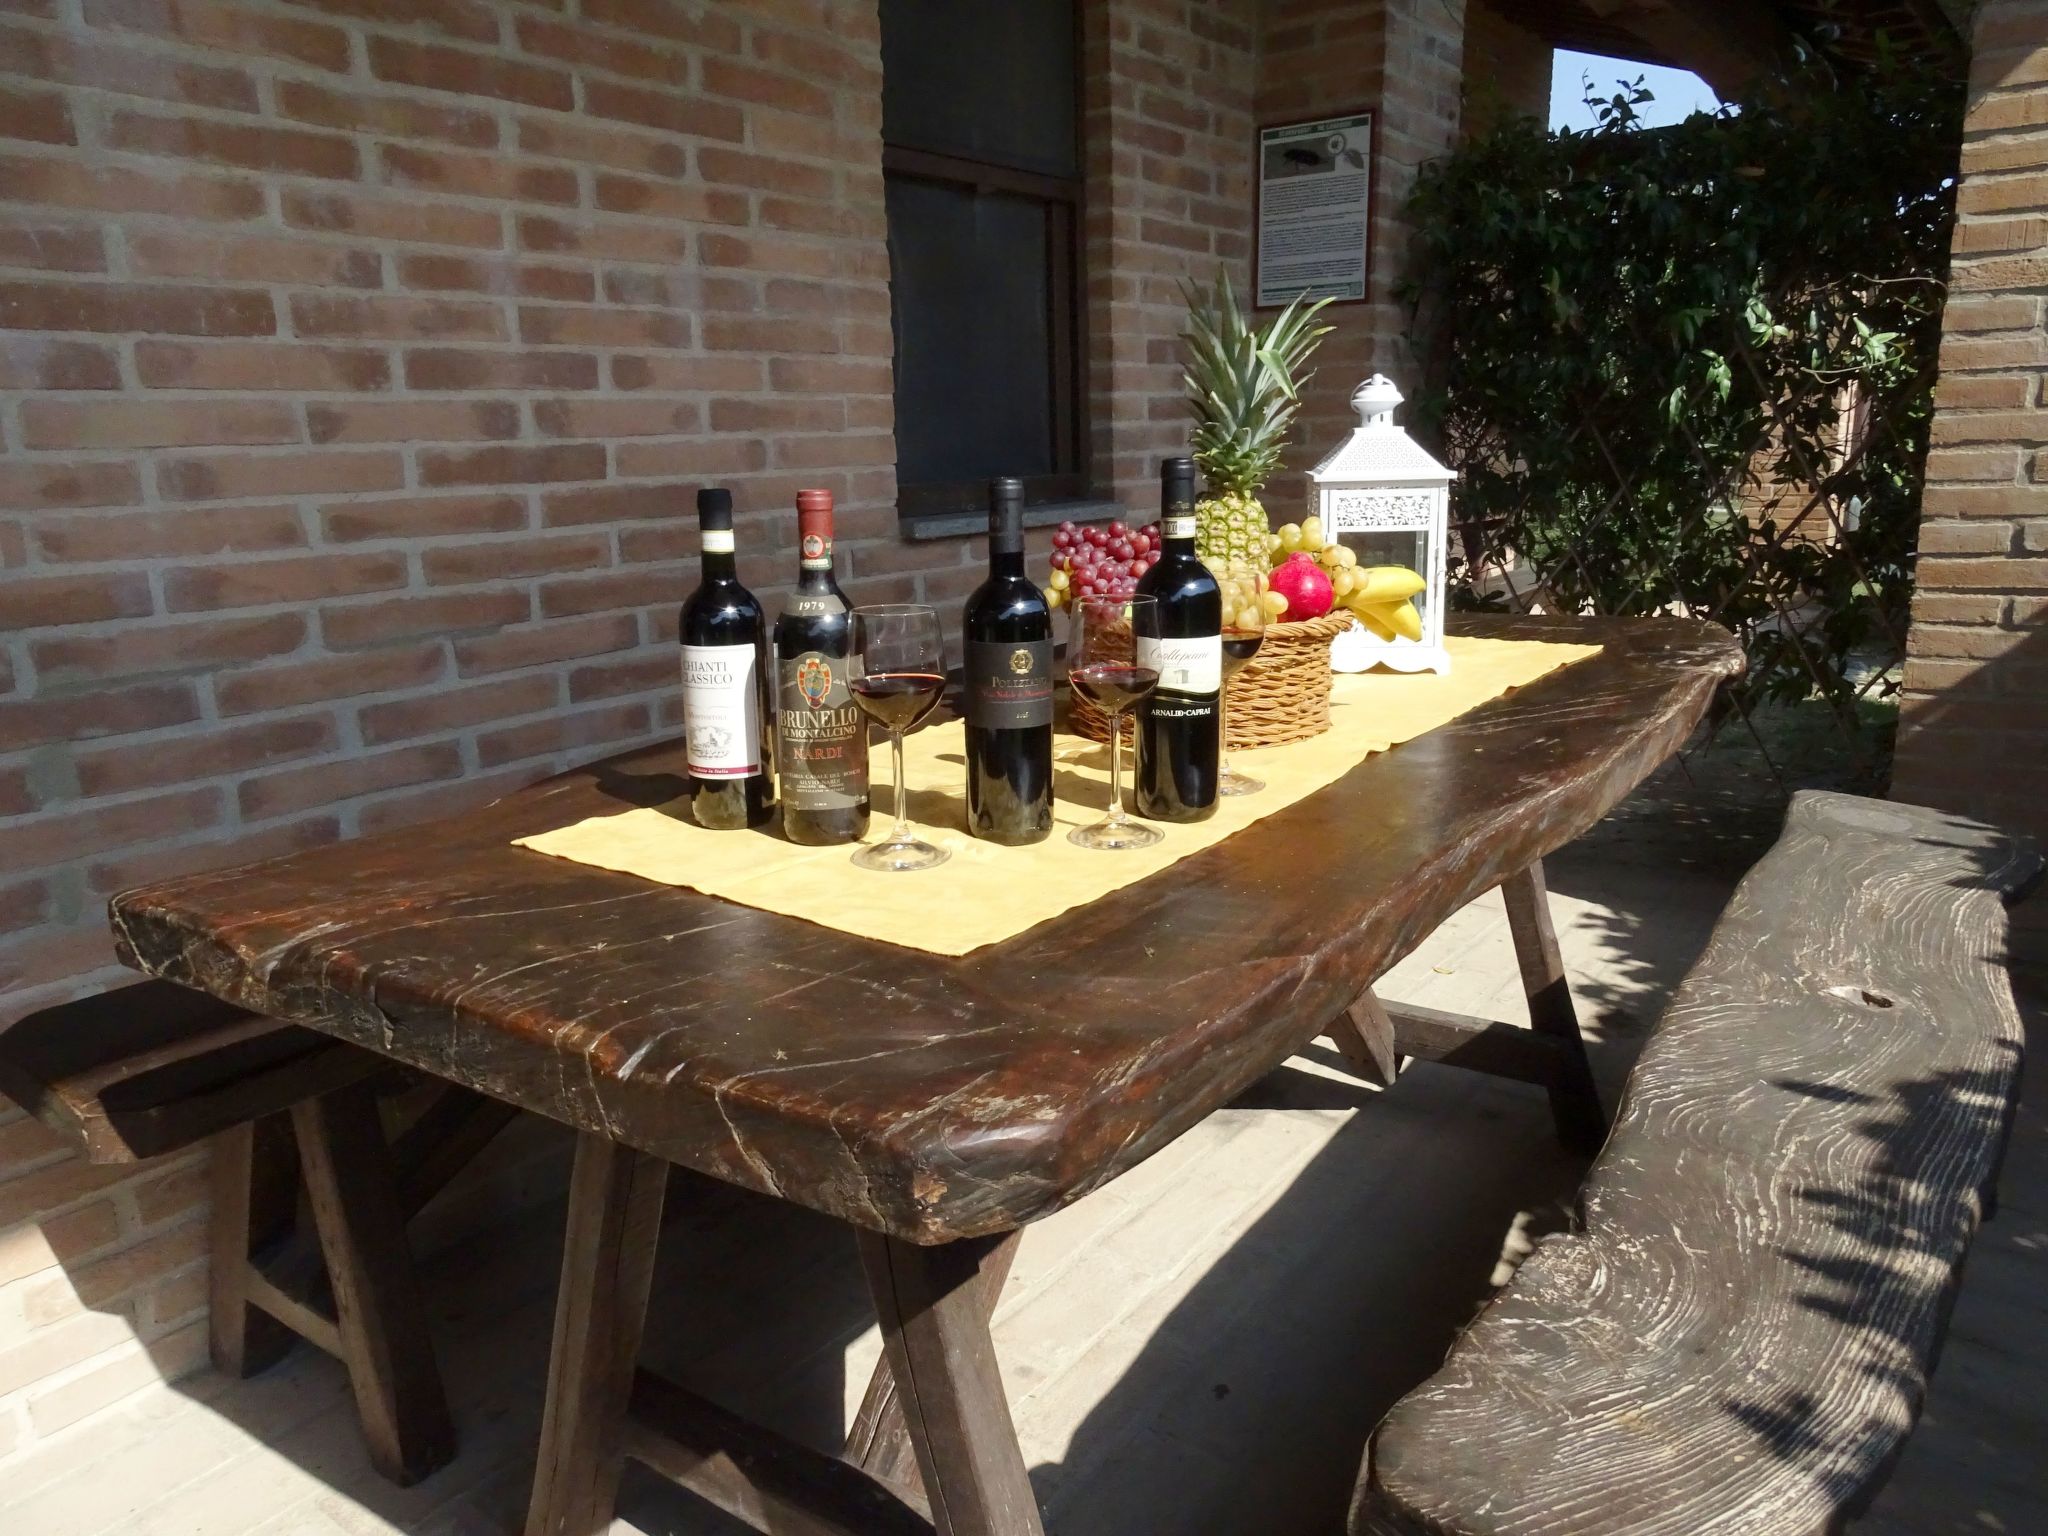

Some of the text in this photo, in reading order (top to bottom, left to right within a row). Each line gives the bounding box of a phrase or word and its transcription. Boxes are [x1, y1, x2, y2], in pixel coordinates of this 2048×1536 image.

[799, 601, 825, 611] 1979
[683, 660, 727, 673] CHIANTI
[681, 672, 733, 685] CLASSICO
[780, 706, 858, 729] BRUNELLO
[782, 725, 857, 738] DI MONTALCINO
[793, 745, 843, 760] NARDI
